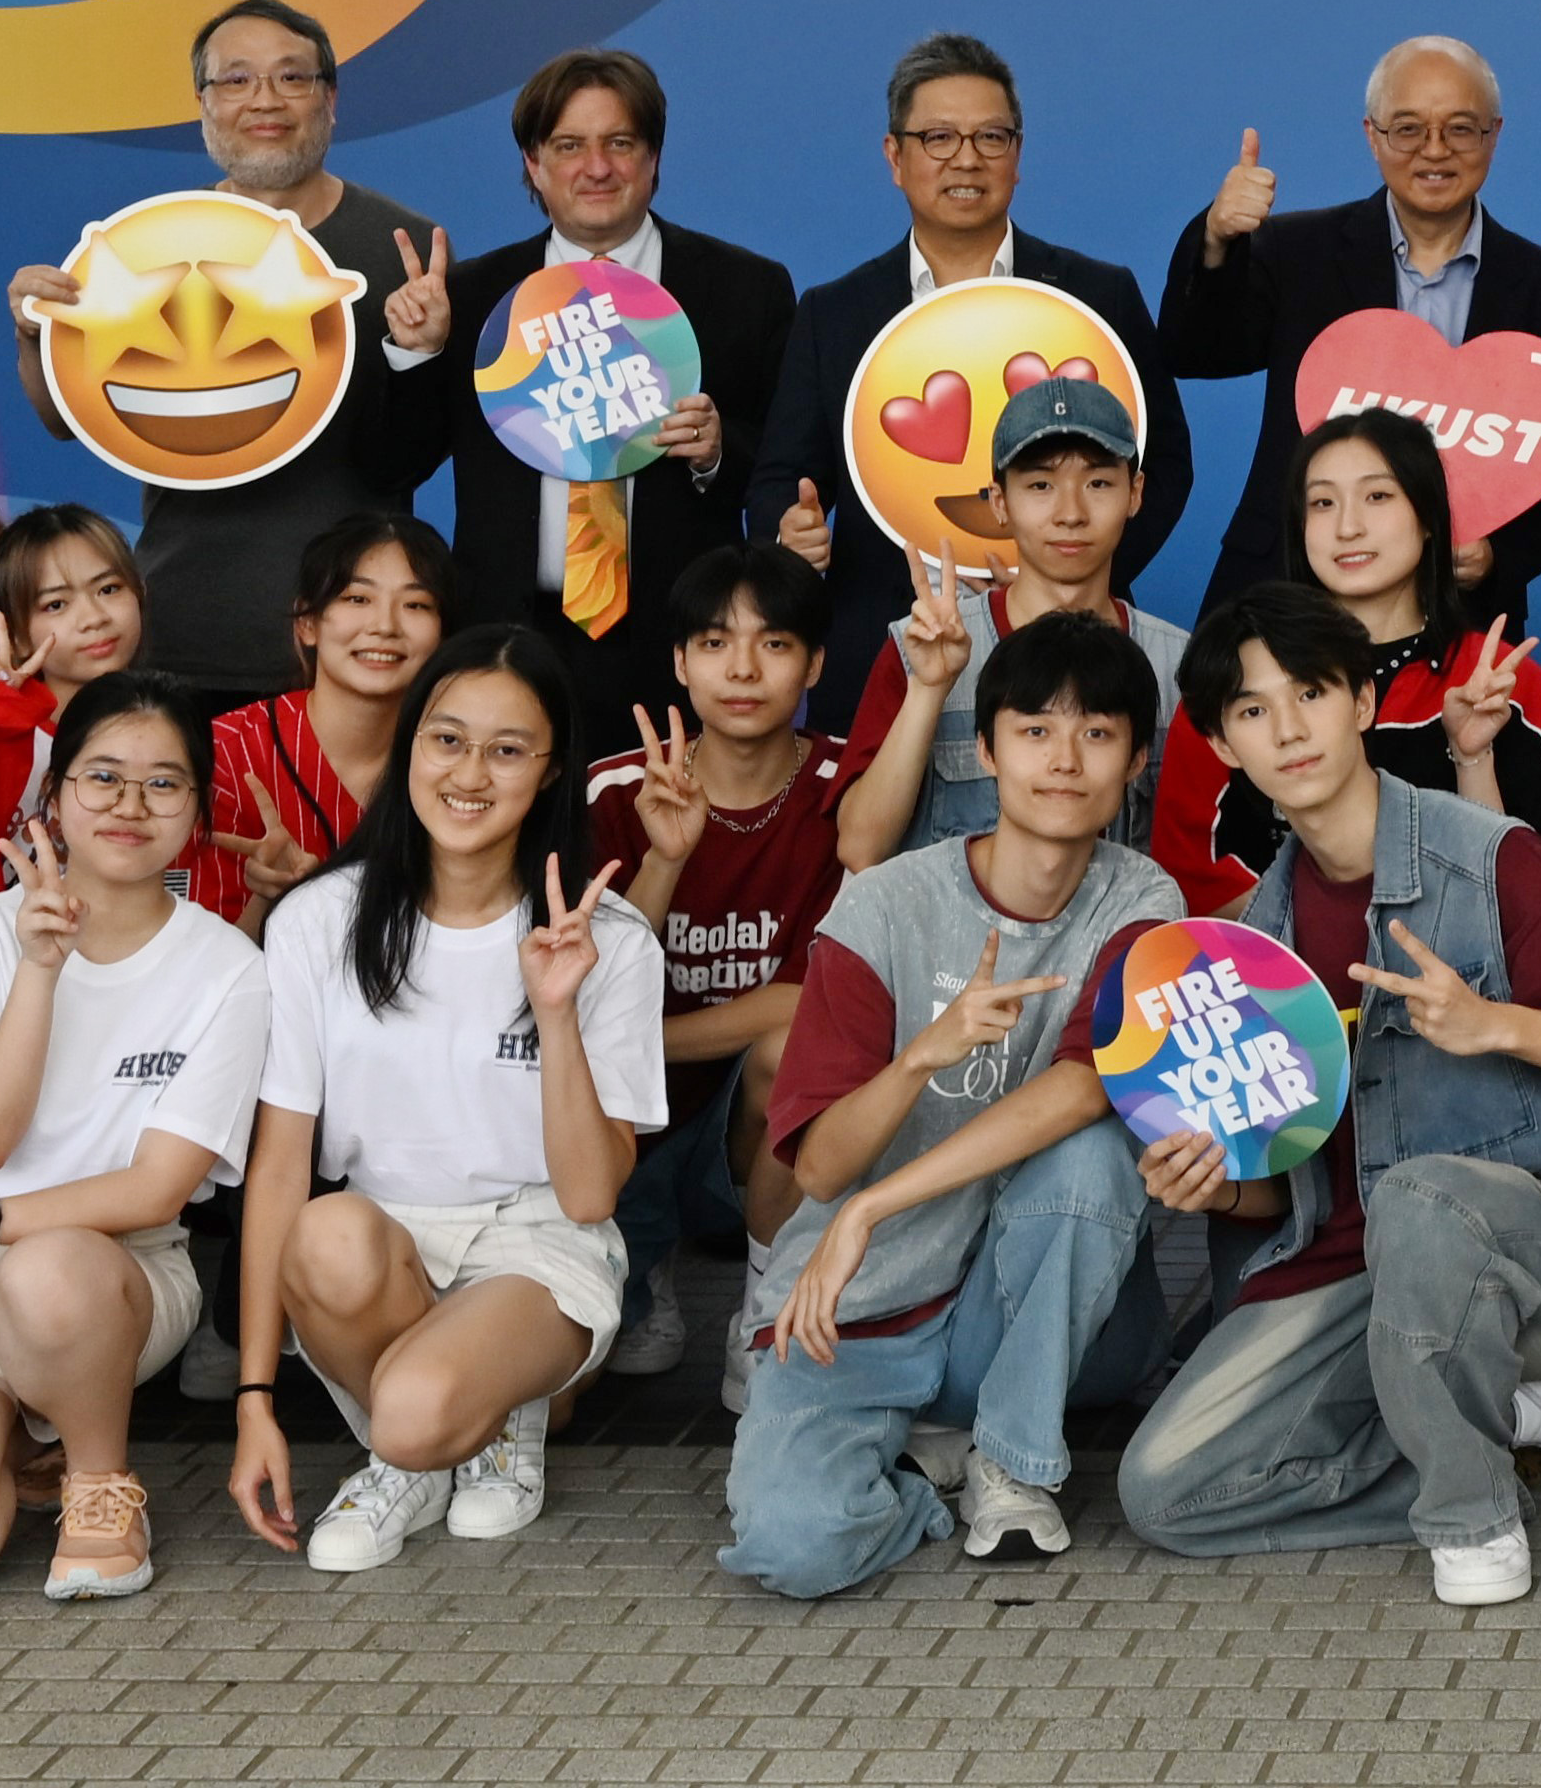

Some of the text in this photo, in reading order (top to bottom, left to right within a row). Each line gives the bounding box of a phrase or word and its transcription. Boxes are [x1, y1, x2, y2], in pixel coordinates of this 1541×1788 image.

[519, 292, 622, 356] FIRE
[546, 332, 612, 379] UP
[529, 353, 659, 420] YOUR
[541, 386, 671, 452] YEAR
[1054, 401, 1068, 417] C
[932, 970, 968, 994] Stay
[1134, 957, 1249, 1032] FIRE
[1170, 1003, 1243, 1061] UP
[1158, 1030, 1301, 1108] YOUR
[1177, 1066, 1319, 1142] YEAR
